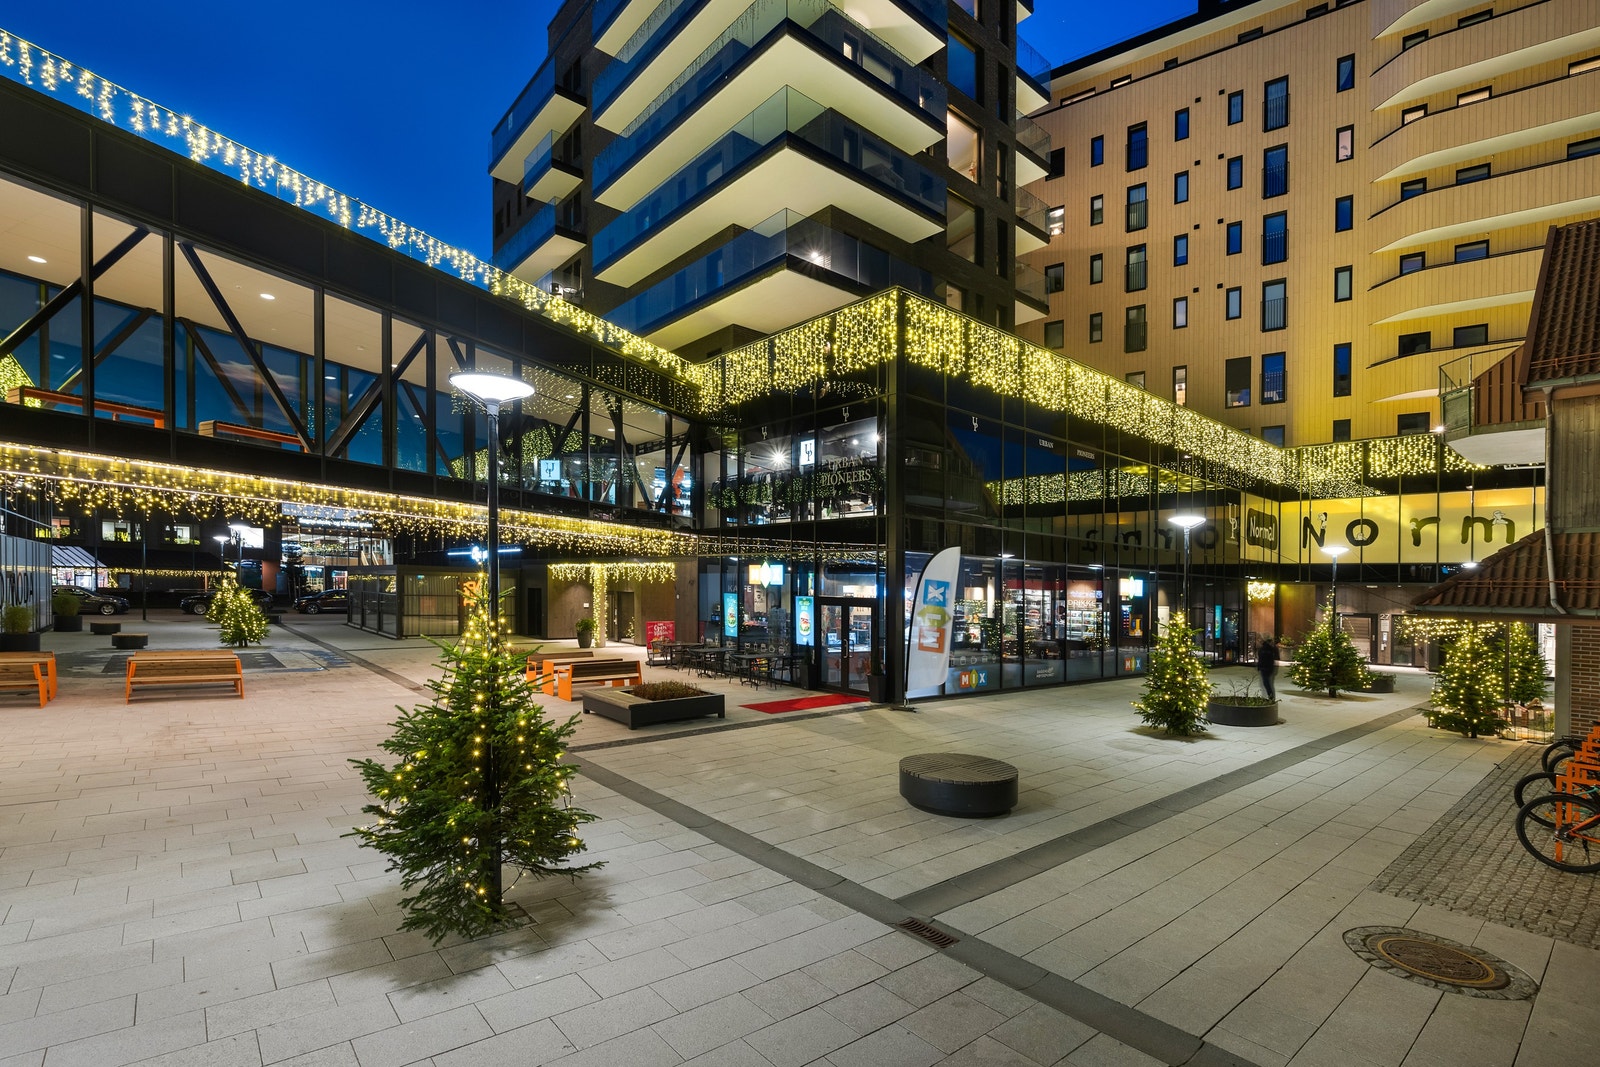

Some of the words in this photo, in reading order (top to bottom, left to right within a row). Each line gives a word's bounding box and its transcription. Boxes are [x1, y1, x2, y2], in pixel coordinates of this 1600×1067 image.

[828, 454, 864, 471] URBAN
[821, 468, 872, 487] PIONEERS
[1249, 515, 1275, 541] Normal
[1067, 599, 1097, 607] DRIKKE
[919, 583, 947, 650] MIX
[1124, 659, 1141, 671] MIX
[961, 672, 986, 686] MIX
